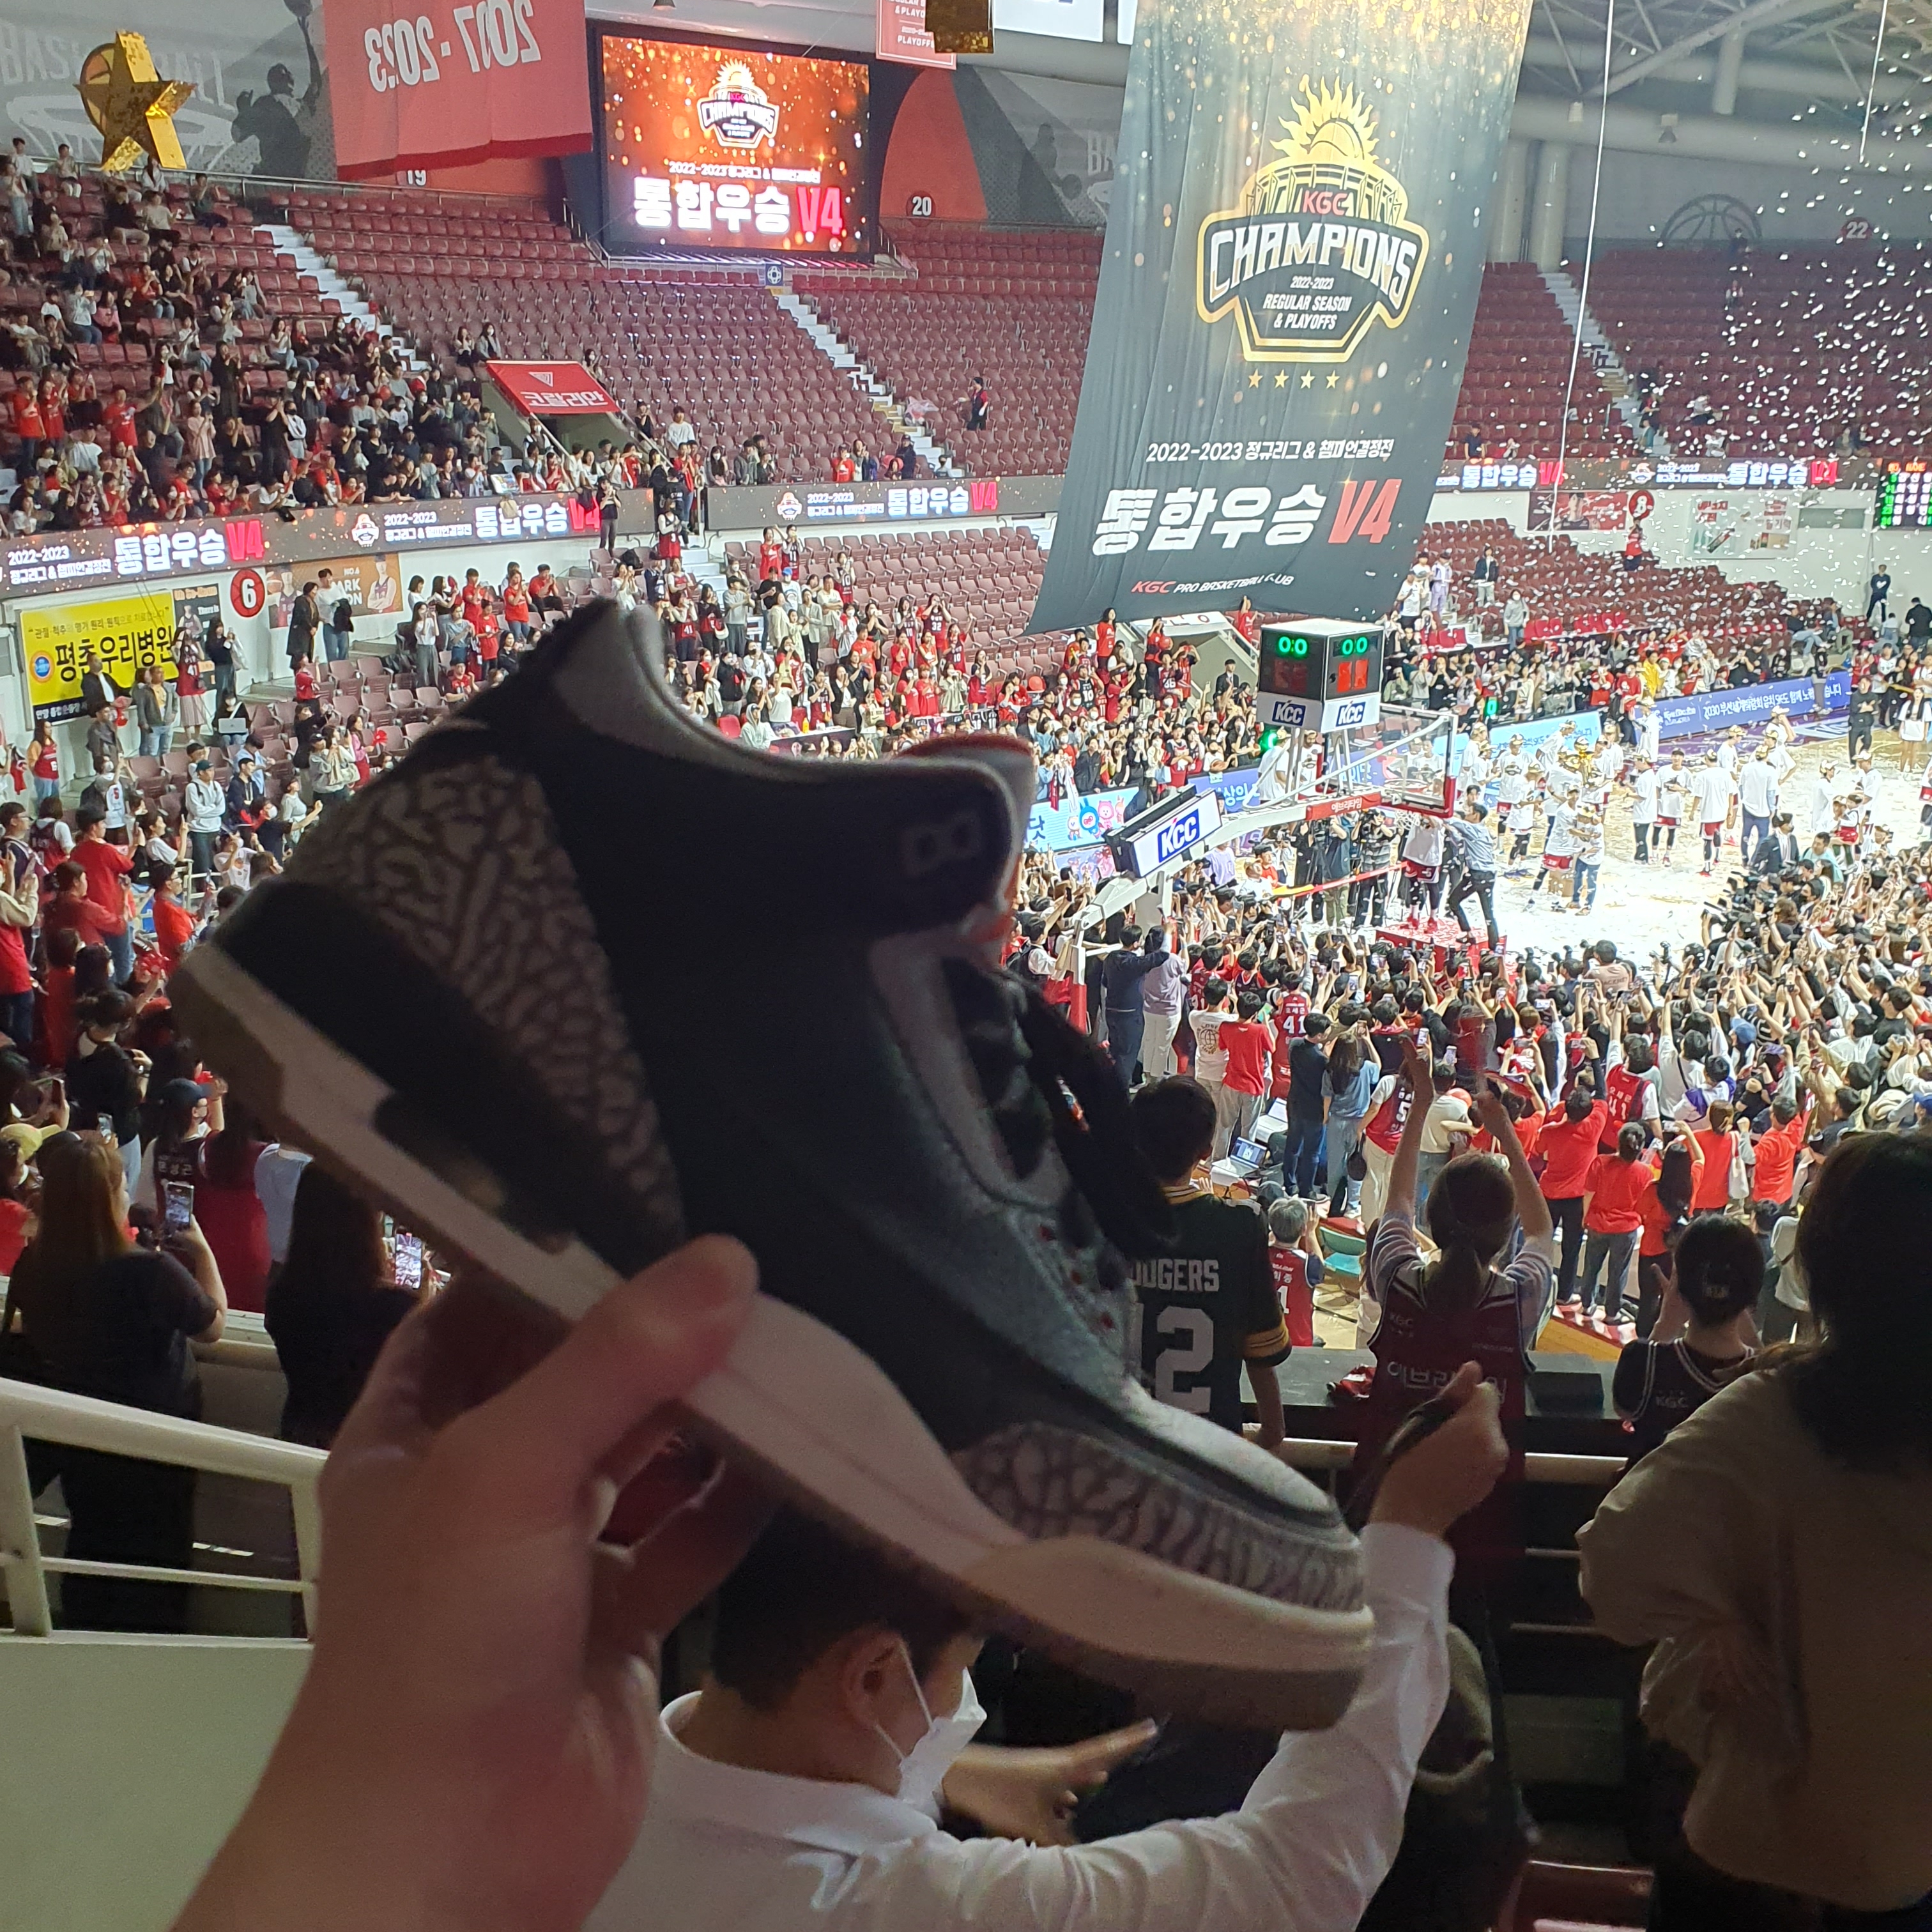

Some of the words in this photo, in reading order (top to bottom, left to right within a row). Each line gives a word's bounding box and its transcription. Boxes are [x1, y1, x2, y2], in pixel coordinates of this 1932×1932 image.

[901, 6, 926, 17] PLAYO
[701, 102, 775, 134] CHAMPIONS
[668, 161, 728, 177] 2022-2023
[634, 176, 790, 234] 통합우승
[796, 186, 843, 235] V4
[913, 196, 931, 217] 20
[1302, 190, 1347, 215] KGC
[1846, 222, 1869, 240] 22
[1210, 222, 1418, 310] CHAMPIONS
[1262, 293, 1312, 310] REGULAR
[1312, 296, 1353, 312] SEASON
[1273, 312, 1284, 328] &
[1284, 313, 1338, 330] PLAYOFFS
[1146, 442, 1243, 462] 2022-2023
[1245, 441, 1301, 461] 정규리그
[1302, 441, 1315, 459] &
[1462, 464, 1537, 488] 통합우승
[1539, 461, 1564, 485] V4
[1728, 463, 1807, 486] 통합우승
[807, 493, 854, 504] 2022-2023
[887, 486, 969, 517] 통합우승
[970, 482, 998, 511] V4
[384, 512, 437, 526] 2022-2023
[1091, 484, 1328, 556] 통합우승
[1328, 479, 1402, 544] V4
[8, 546, 70, 565] 2022-2023
[114, 528, 226, 574] 통합우승
[226, 520, 264, 562] V4
[243, 578, 256, 609] 6
[337, 578, 362, 593] ARK
[1131, 581, 1177, 594] KGC
[1173, 583, 1199, 593] PRO
[931, 622, 942, 631] 32
[1275, 701, 1303, 724] KCC
[1338, 702, 1363, 724] KCC
[1331, 798, 1362, 812] 에브리타임
[1161, 818, 1199, 858] KCC
[1283, 1015, 1307, 1034] 41
